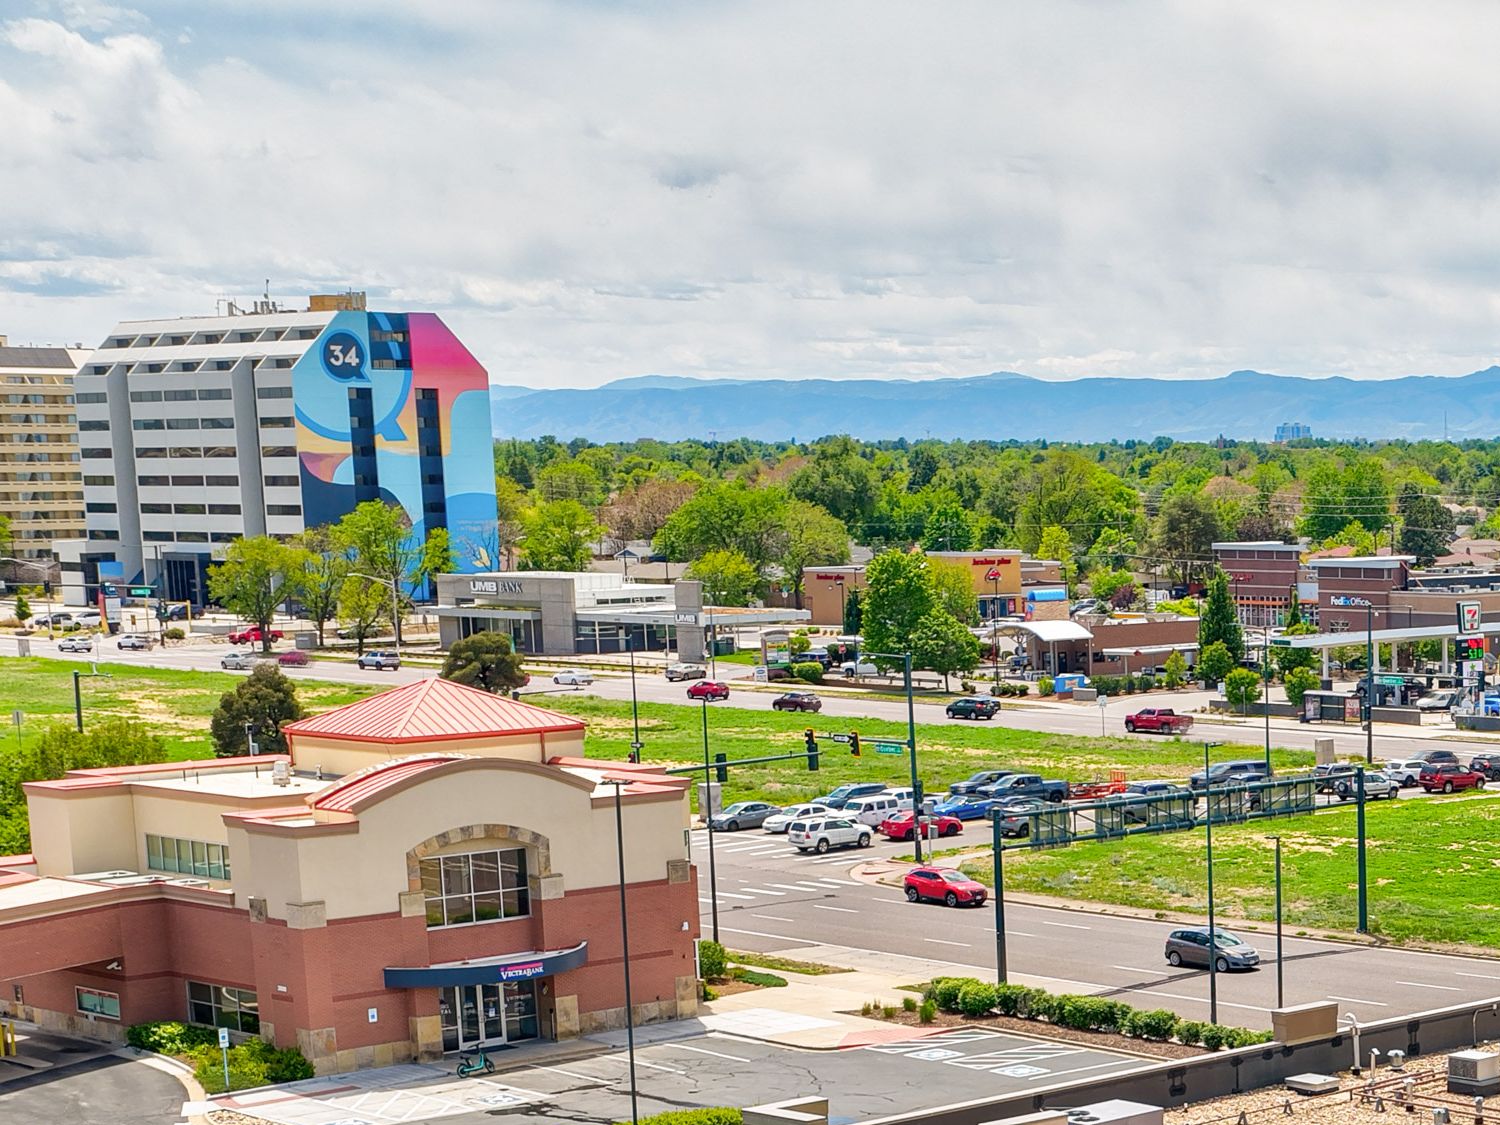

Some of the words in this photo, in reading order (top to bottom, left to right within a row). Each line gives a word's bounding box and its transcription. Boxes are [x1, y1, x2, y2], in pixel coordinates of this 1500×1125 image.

[329, 344, 360, 367] 34
[470, 581, 497, 592] UMB
[675, 613, 696, 625] UMB
